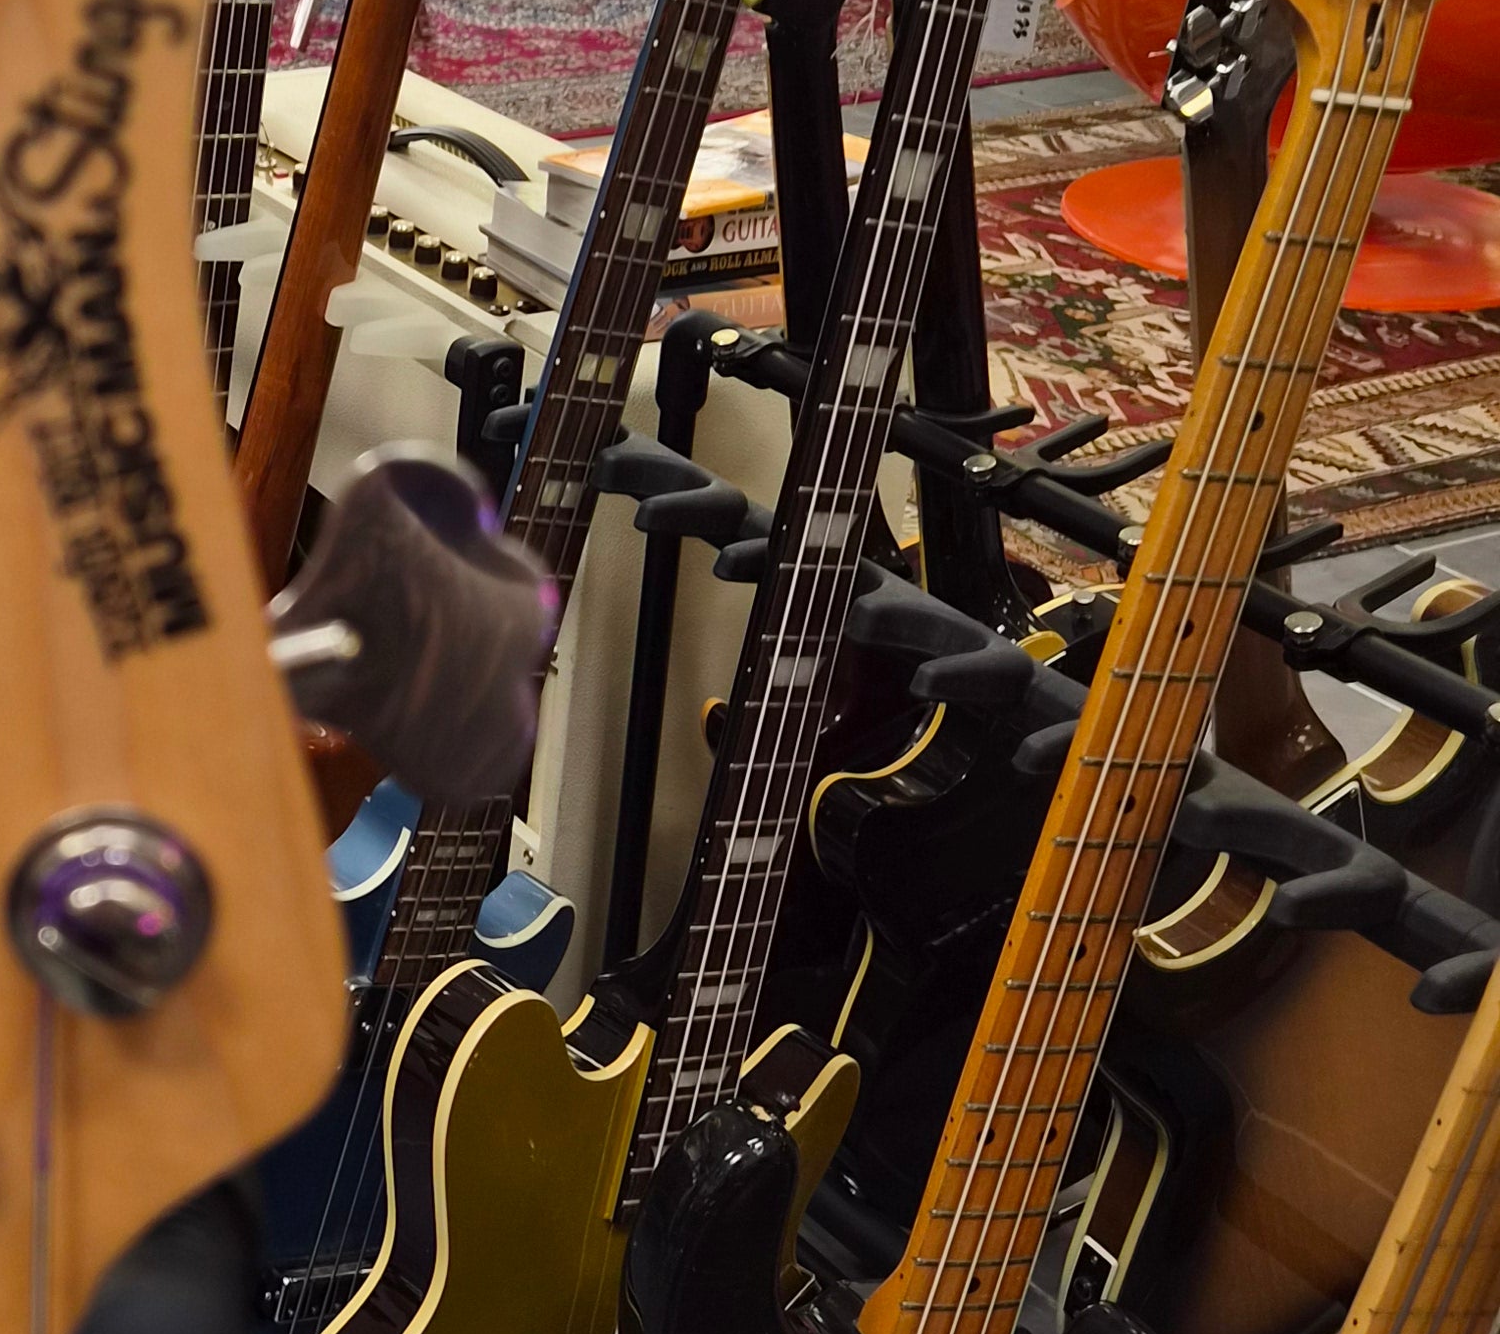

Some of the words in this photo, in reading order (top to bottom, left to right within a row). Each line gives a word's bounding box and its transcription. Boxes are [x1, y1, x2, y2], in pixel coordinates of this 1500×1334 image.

[722, 215, 779, 243] GUITA
[663, 262, 689, 278] OCK
[709, 254, 742, 272] ROLL
[743, 249, 780, 267] ALMA
[711, 293, 784, 318] GUITA
[106, 405, 209, 639] MUSIC
